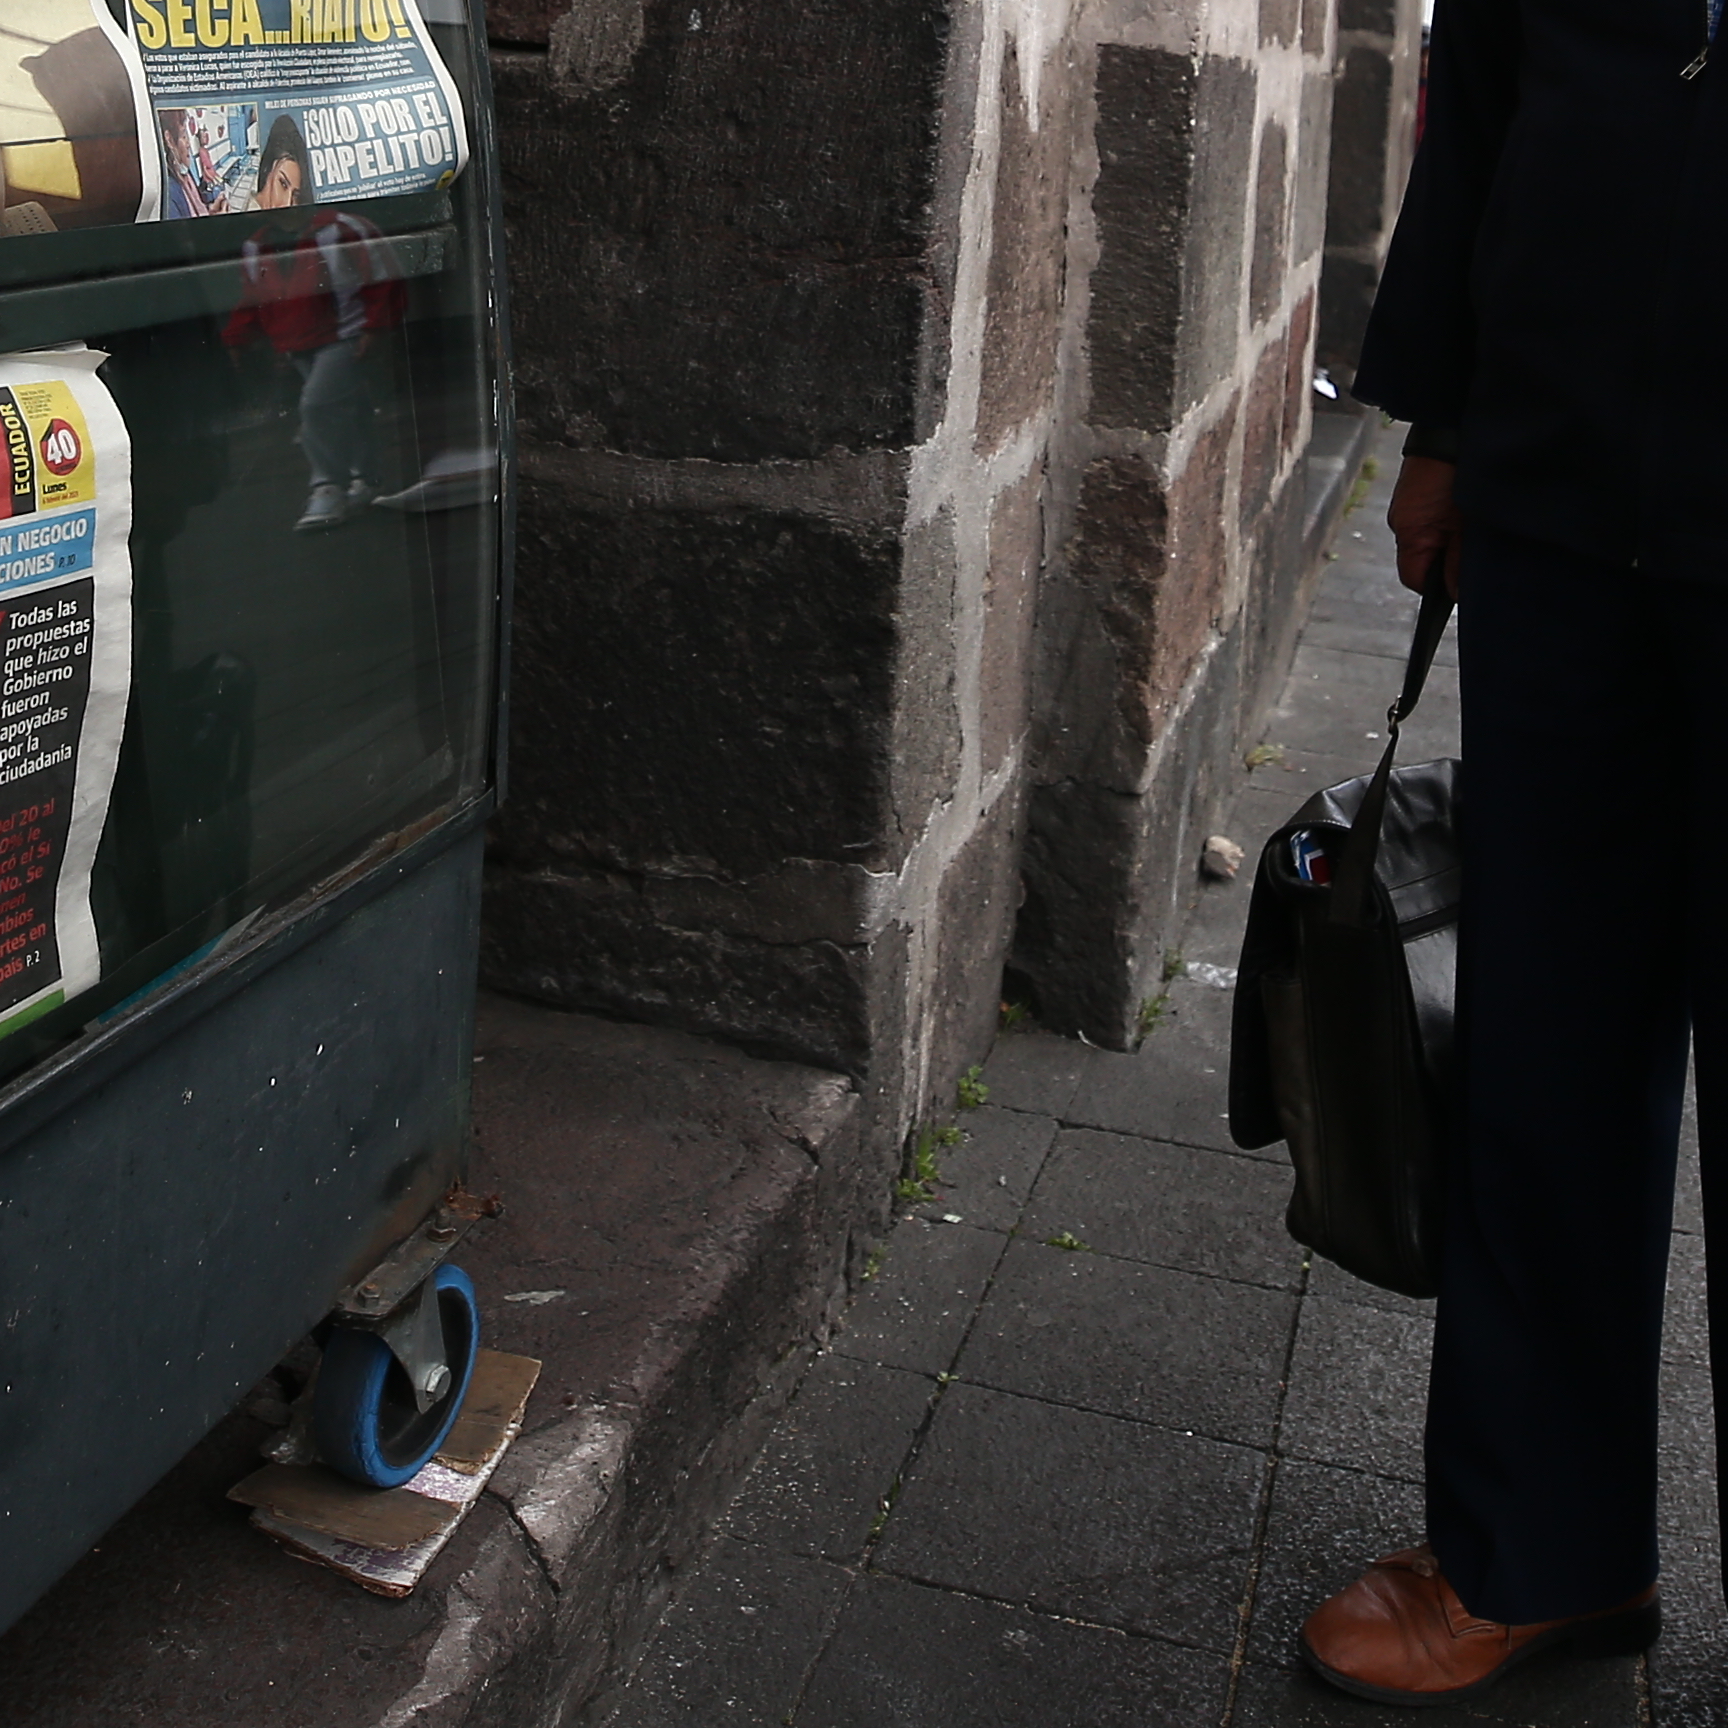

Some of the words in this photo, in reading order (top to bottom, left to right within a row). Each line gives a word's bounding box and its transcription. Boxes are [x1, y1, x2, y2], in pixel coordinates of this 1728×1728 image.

[373, 89, 391, 98] POR
[392, 81, 436, 96] NECESIDAD
[303, 105, 360, 149] ¡SOLO
[357, 97, 417, 138] POR
[412, 91, 448, 129] EL
[309, 126, 454, 188] PAPELITO!
[46, 428, 77, 465] 40
[42, 482, 68, 495] Lunes
[16, 516, 88, 553] NEGOCIO
[9, 605, 54, 631] Todas
[57, 599, 78, 619] las
[4, 617, 91, 657] propuestas
[3, 653, 34, 678] que
[37, 645, 71, 667] hizo
[73, 636, 89, 655] el
[2, 664, 74, 697] Gobierno
[0, 690, 51, 719] fueron
[27, 734, 40, 753] la
[19, 804, 40, 827] 20
[41, 797, 56, 817] al
[26, 826, 42, 843] le
[20, 845, 35, 865] el
[25, 864, 45, 884] Se
[29, 922, 47, 942] en
[25, 953, 35, 968] P.
[34, 949, 41, 963] 2
